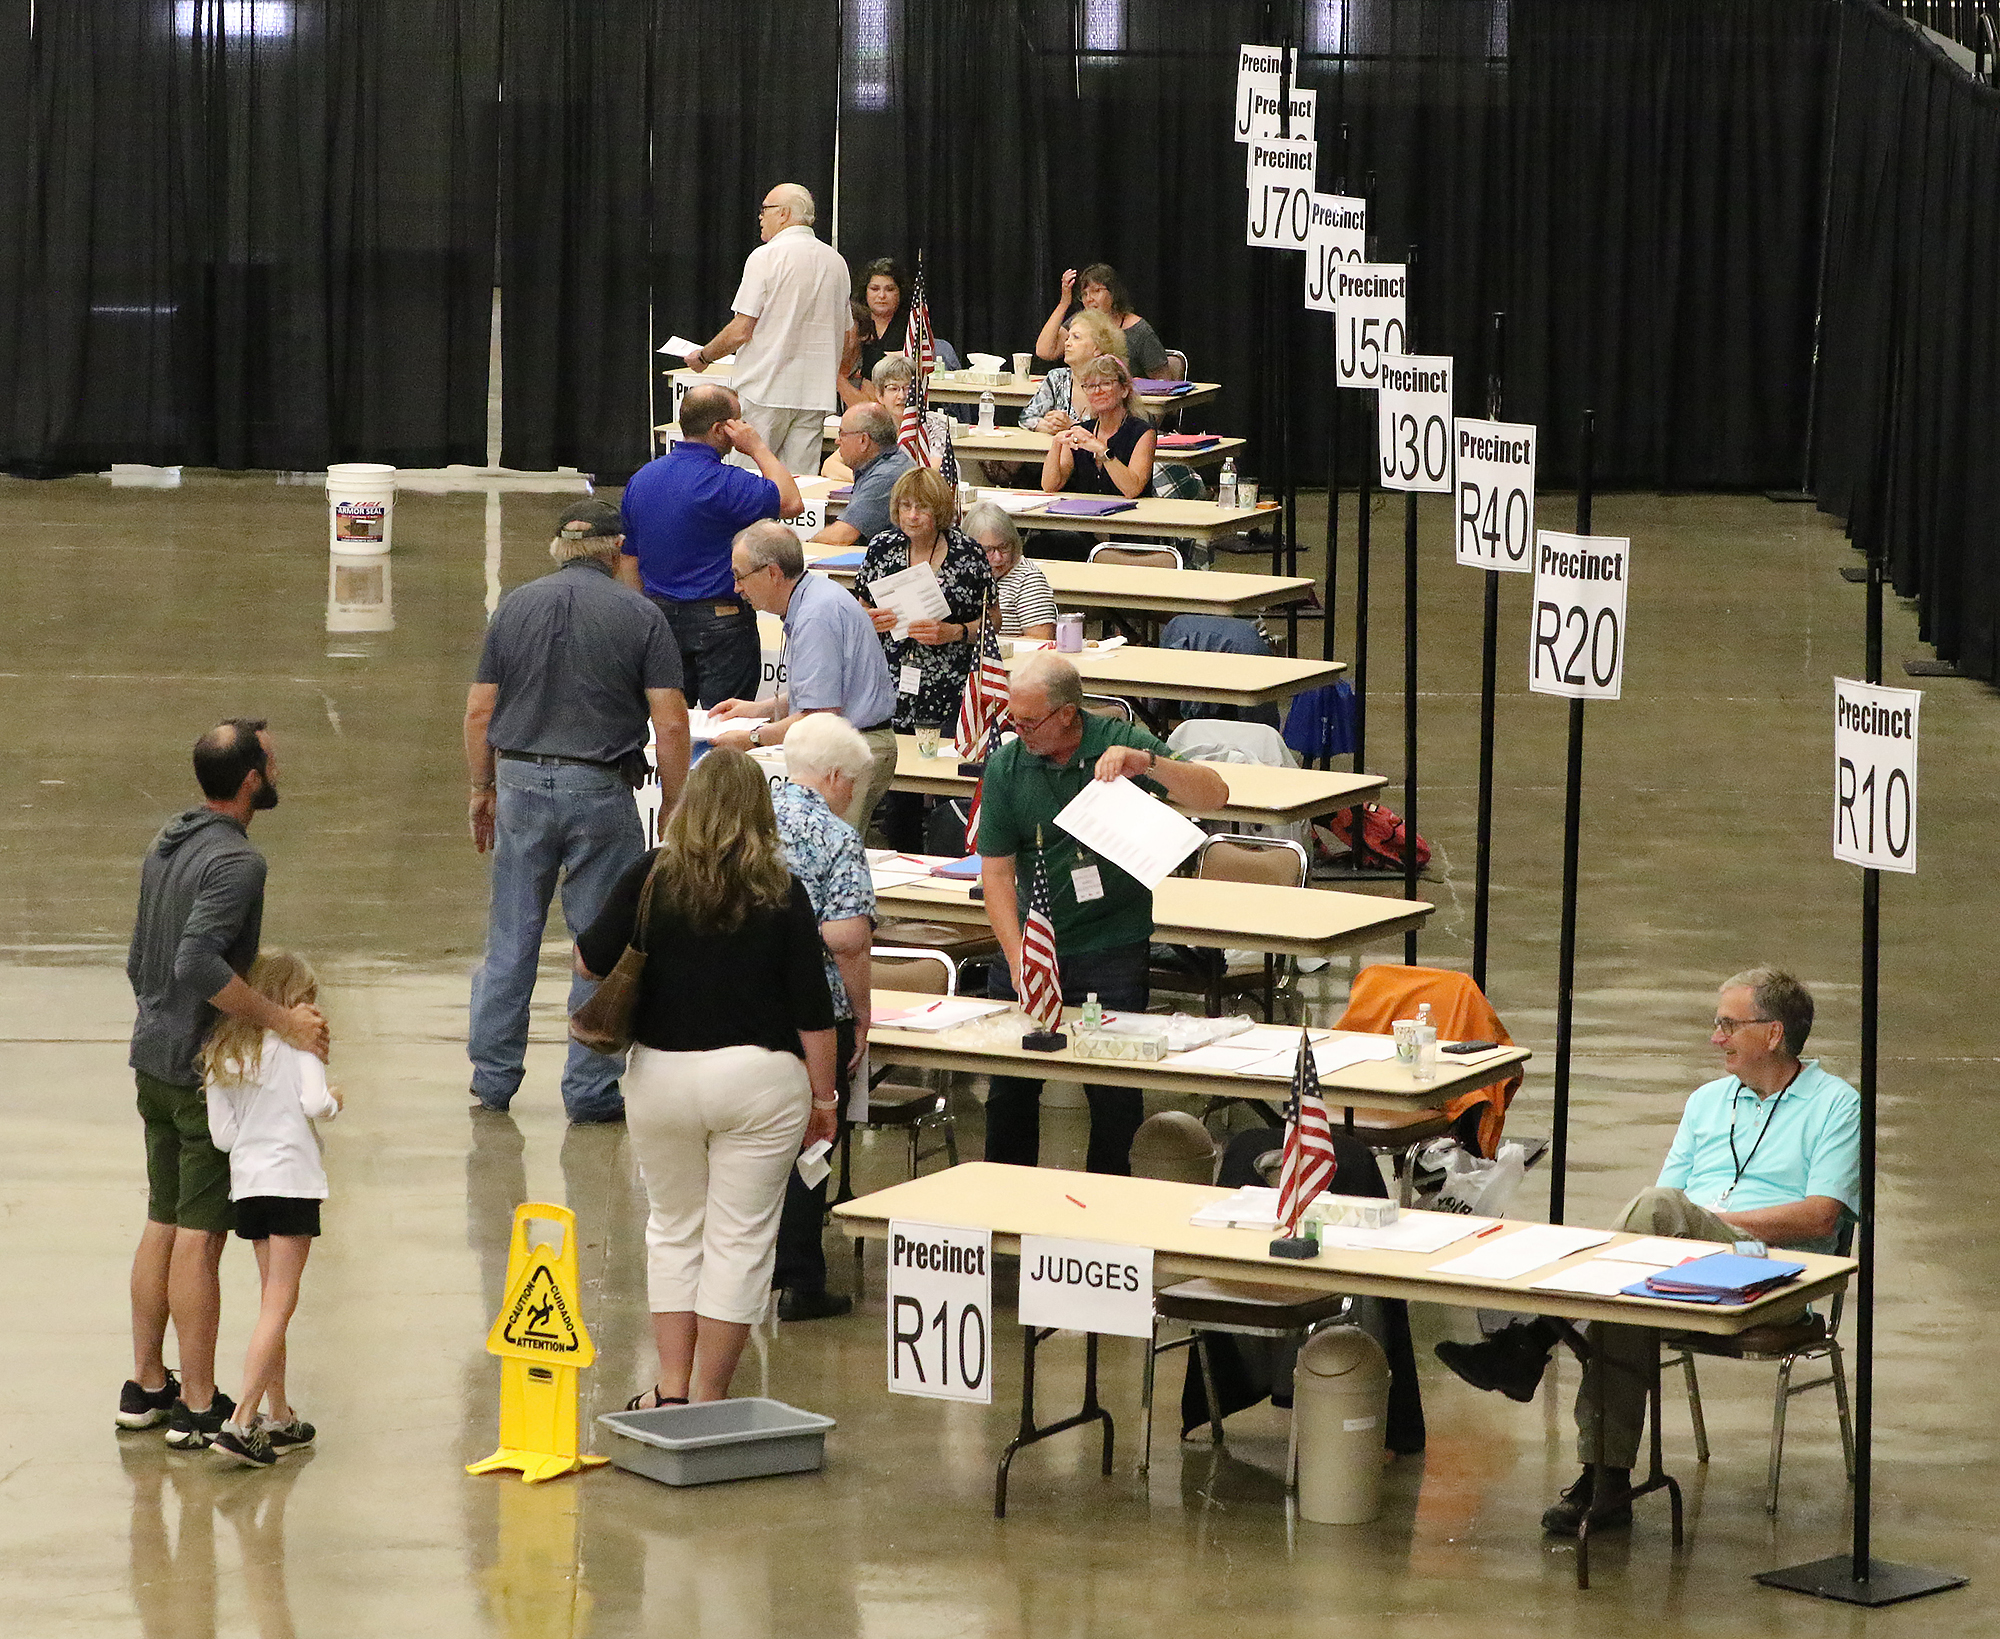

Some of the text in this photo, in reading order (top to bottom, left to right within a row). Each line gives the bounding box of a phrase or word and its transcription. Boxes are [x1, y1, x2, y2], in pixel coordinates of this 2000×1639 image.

[1254, 146, 1312, 171] Precinct
[1251, 184, 1310, 242] J70
[1312, 203, 1364, 231] Precinct
[1339, 274, 1405, 298] Precinct
[1382, 363, 1448, 394] Precinct
[1384, 412, 1447, 482] J30
[1459, 431, 1531, 465] Precinct
[1460, 482, 1528, 561] R40
[1541, 545, 1622, 581] Precinct
[1535, 601, 1618, 687] R20
[1838, 694, 1911, 740] Precinct
[1839, 757, 1911, 858] R10
[893, 1235, 985, 1276] Precinct
[1030, 1255, 1139, 1292] JUDGES
[509, 1281, 535, 1324] CAUTION
[550, 1285, 574, 1332] CUIDADO
[516, 1337, 565, 1353] ATTENTION
[893, 1295, 985, 1390] R10
